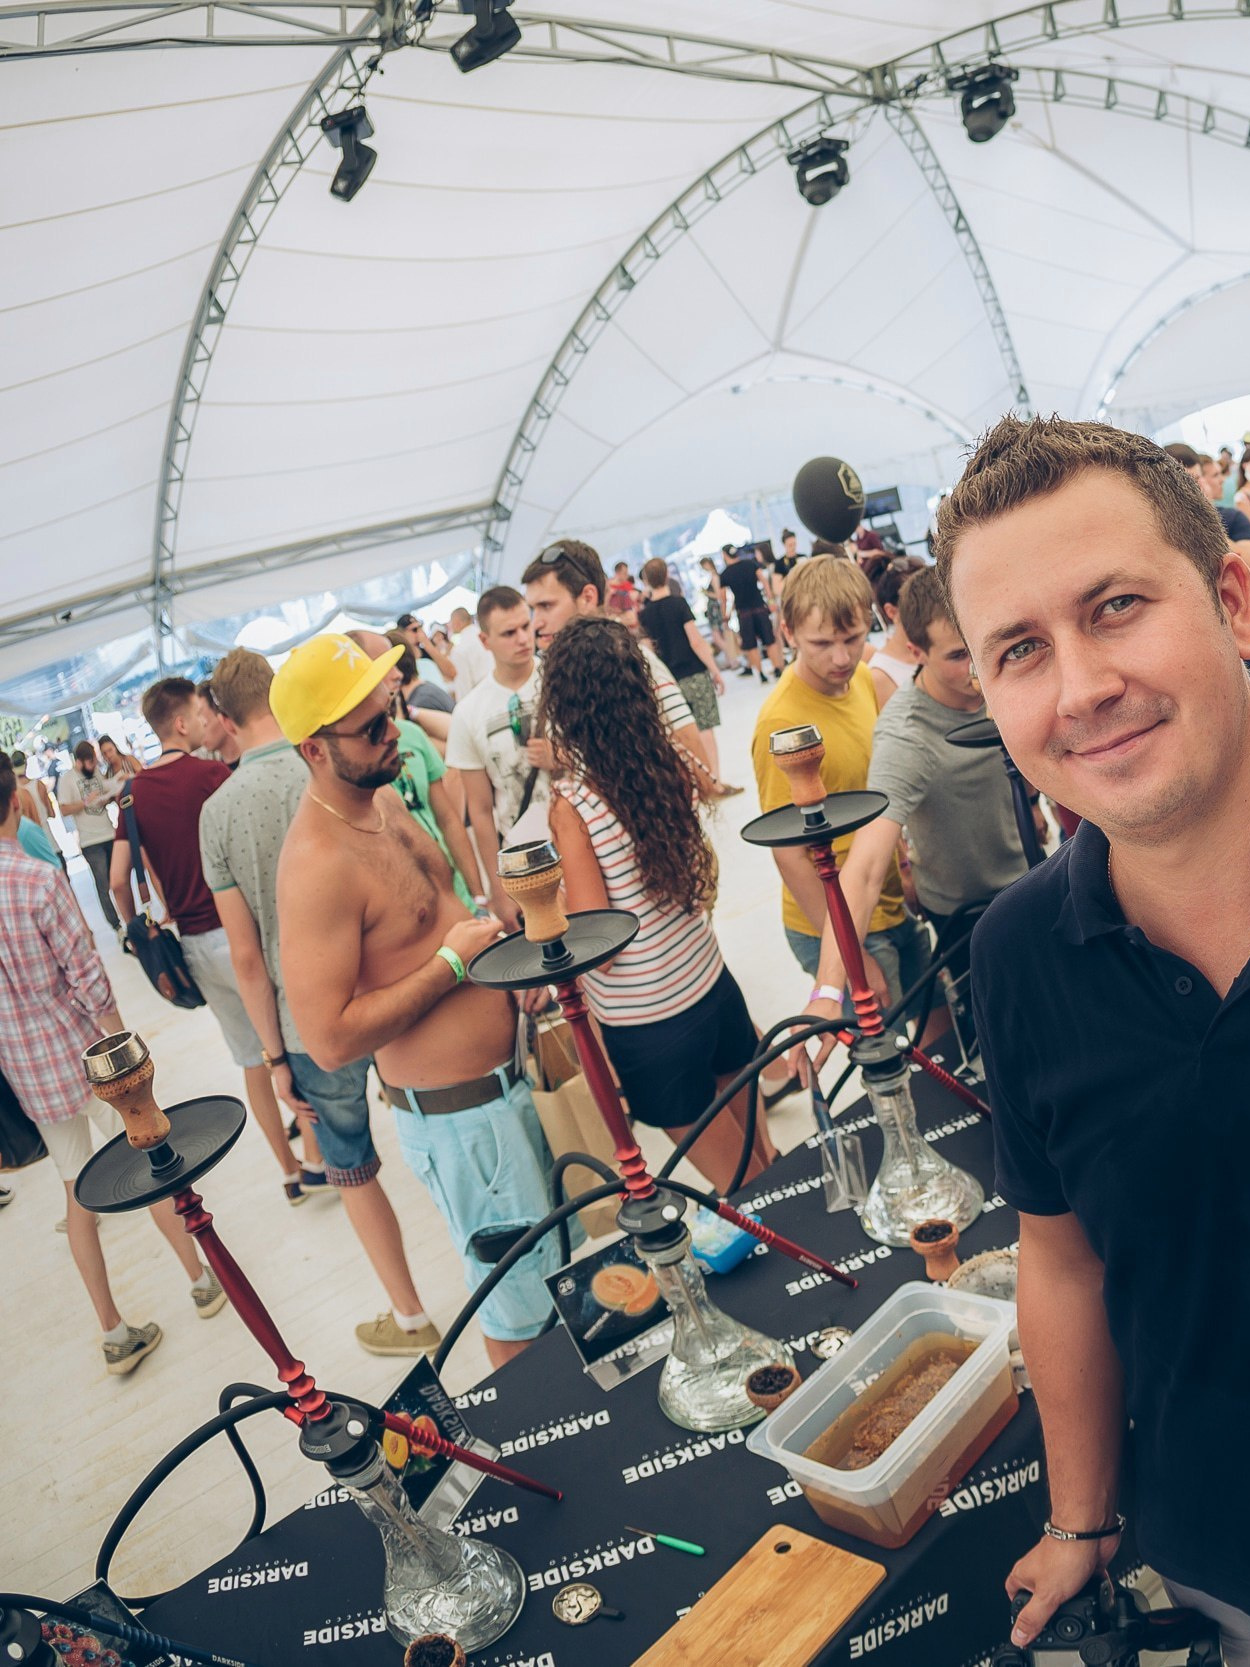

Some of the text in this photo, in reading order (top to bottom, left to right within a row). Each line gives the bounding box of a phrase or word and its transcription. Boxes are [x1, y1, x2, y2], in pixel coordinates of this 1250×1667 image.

[500, 1409, 611, 1458] DARKSIDE
[622, 1428, 745, 1485] DARKSIDE
[939, 1460, 1040, 1518] DARKSIDE
[207, 1561, 309, 1594] DARKSIDE
[528, 1536, 656, 1592] DARKSIDE
[303, 1616, 387, 1646] RKSIDE
[849, 1593, 949, 1660] DARKSIDE
